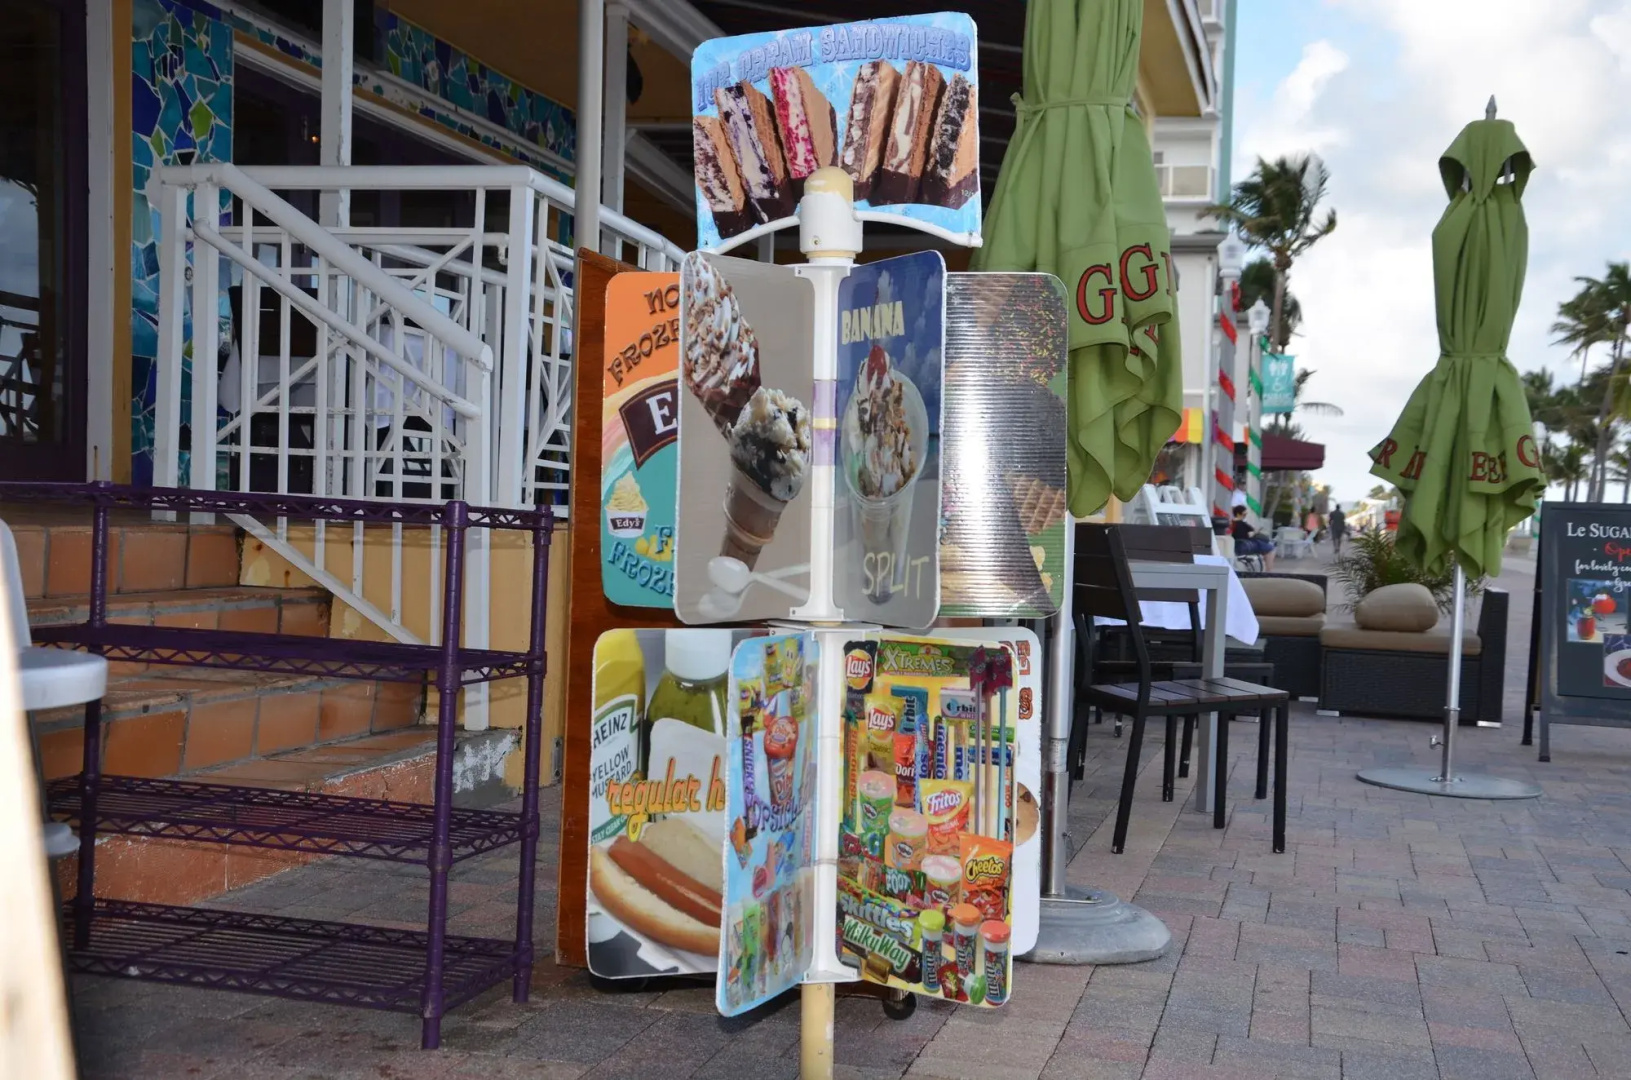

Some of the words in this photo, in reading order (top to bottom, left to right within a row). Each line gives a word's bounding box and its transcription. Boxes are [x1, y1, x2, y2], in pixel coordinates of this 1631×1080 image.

[738, 31, 812, 82] CREAM
[821, 24, 971, 71] SANDWICHES
[842, 300, 905, 345] BANANA
[616, 518, 641, 528] Edy's
[1567, 522, 1586, 537] Le
[1589, 523, 1631, 538] SUGA
[861, 551, 929, 599] SPLIT
[884, 646, 952, 671] XTREMES
[594, 713, 627, 749] HEINZ
[593, 744, 629, 783] YELLOW
[606, 756, 701, 842] regular
[927, 792, 961, 813] Fritos
[966, 857, 1004, 883] Cheetos
[841, 892, 913, 938] Skittles
[844, 919, 880, 953] Milky
[879, 935, 909, 970] Way
